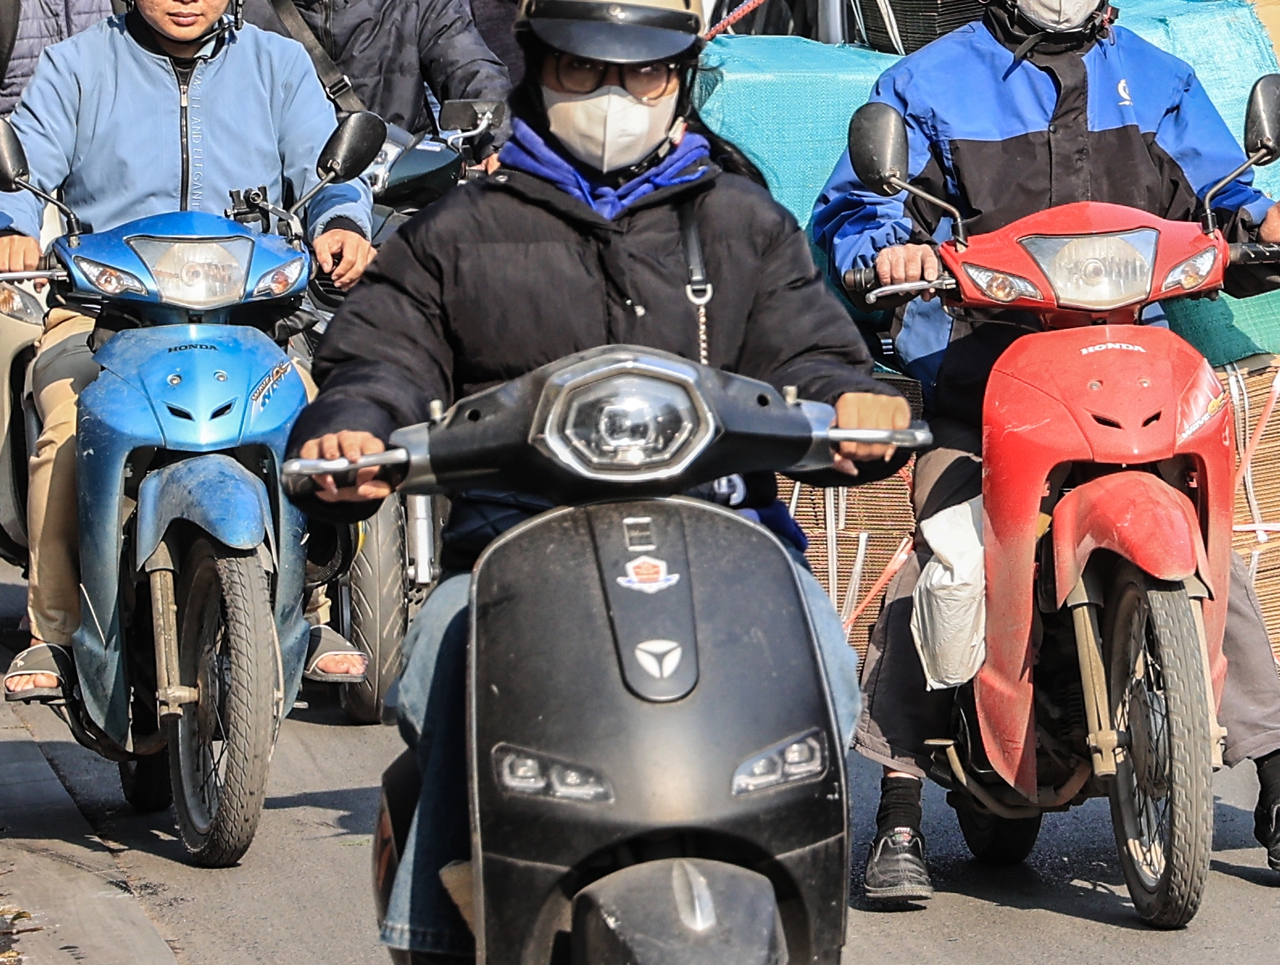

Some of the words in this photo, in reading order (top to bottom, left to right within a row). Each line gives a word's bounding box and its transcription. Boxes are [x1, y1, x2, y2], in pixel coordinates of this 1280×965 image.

[191, 116, 202, 144] AND
[167, 343, 219, 353] HONDA
[1080, 342, 1147, 355] HONDA
